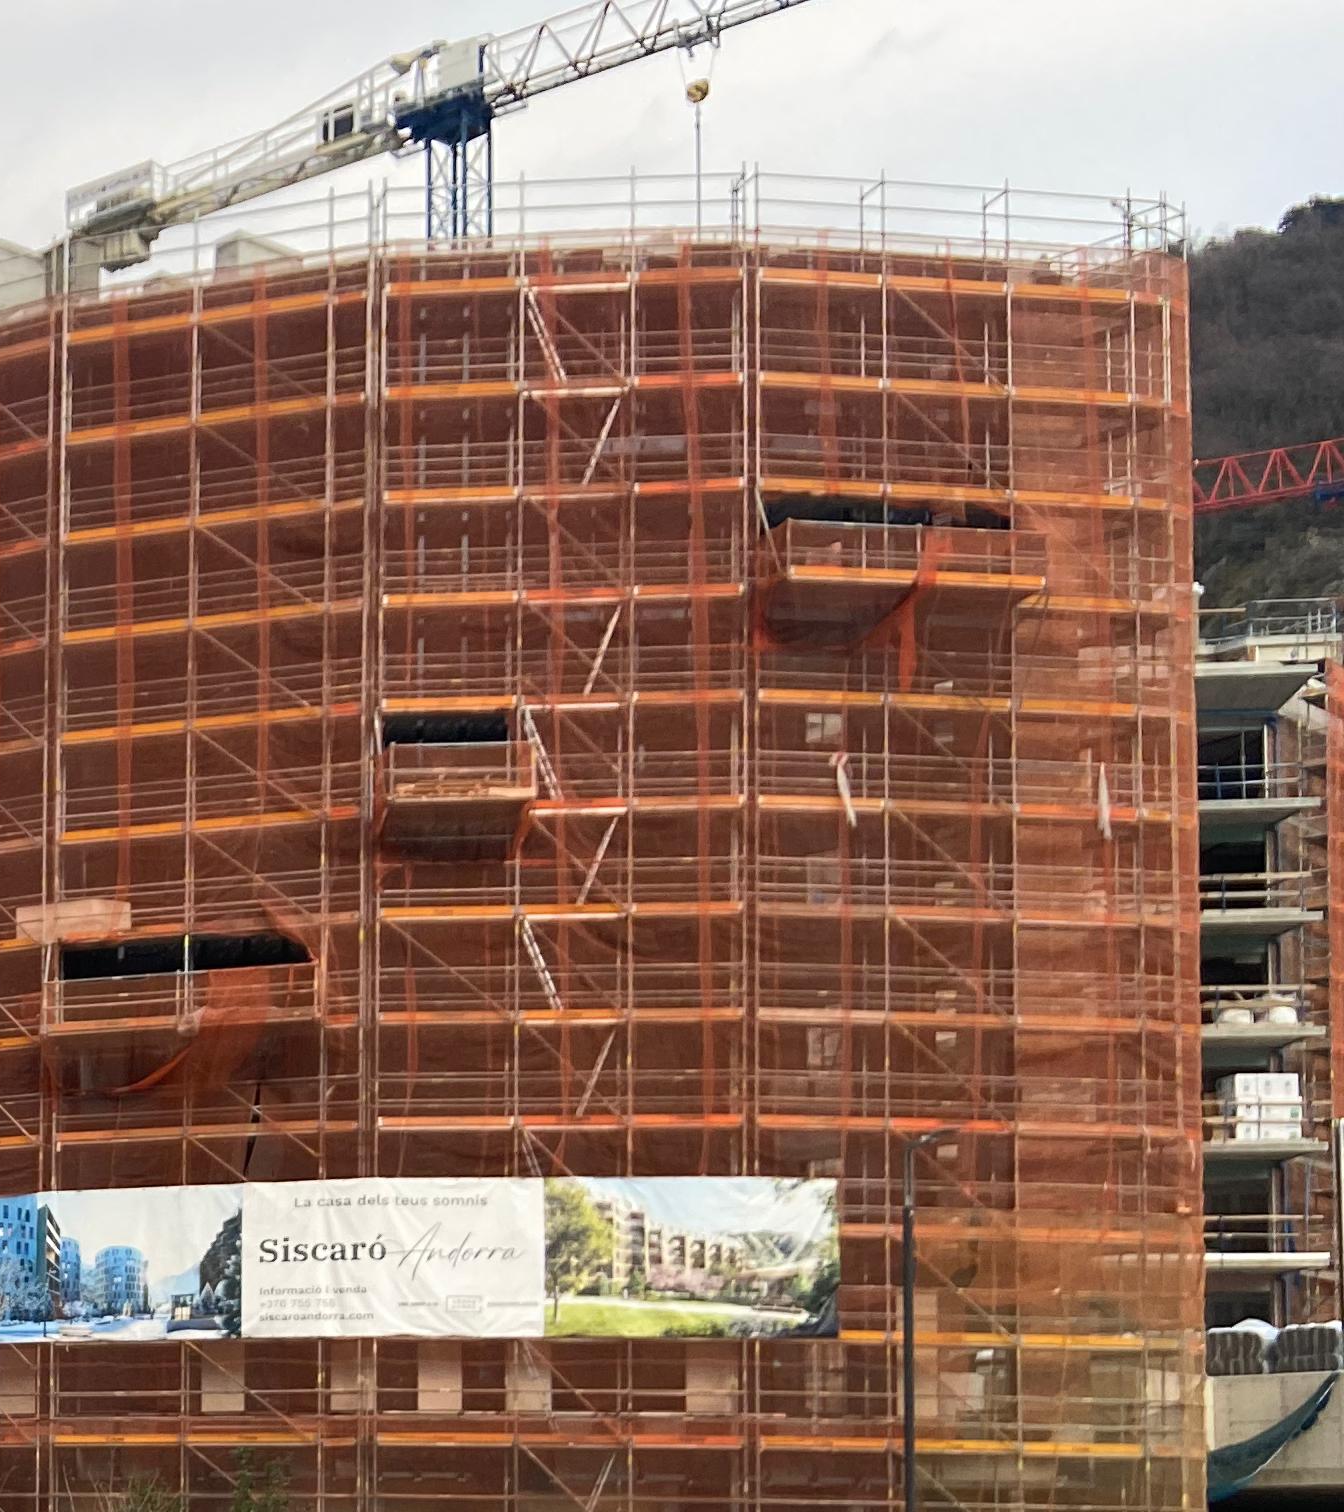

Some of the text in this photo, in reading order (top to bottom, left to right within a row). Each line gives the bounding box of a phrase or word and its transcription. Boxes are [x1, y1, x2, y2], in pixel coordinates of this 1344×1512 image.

[294, 1193, 488, 1208] La casa dels teus somnis
[259, 1221, 524, 1280] Siscaró Andorra
[259, 1285, 322, 1295] Informació
[333, 1285, 367, 1294] venda
[259, 1311, 374, 1321] siscaroandorra.com
